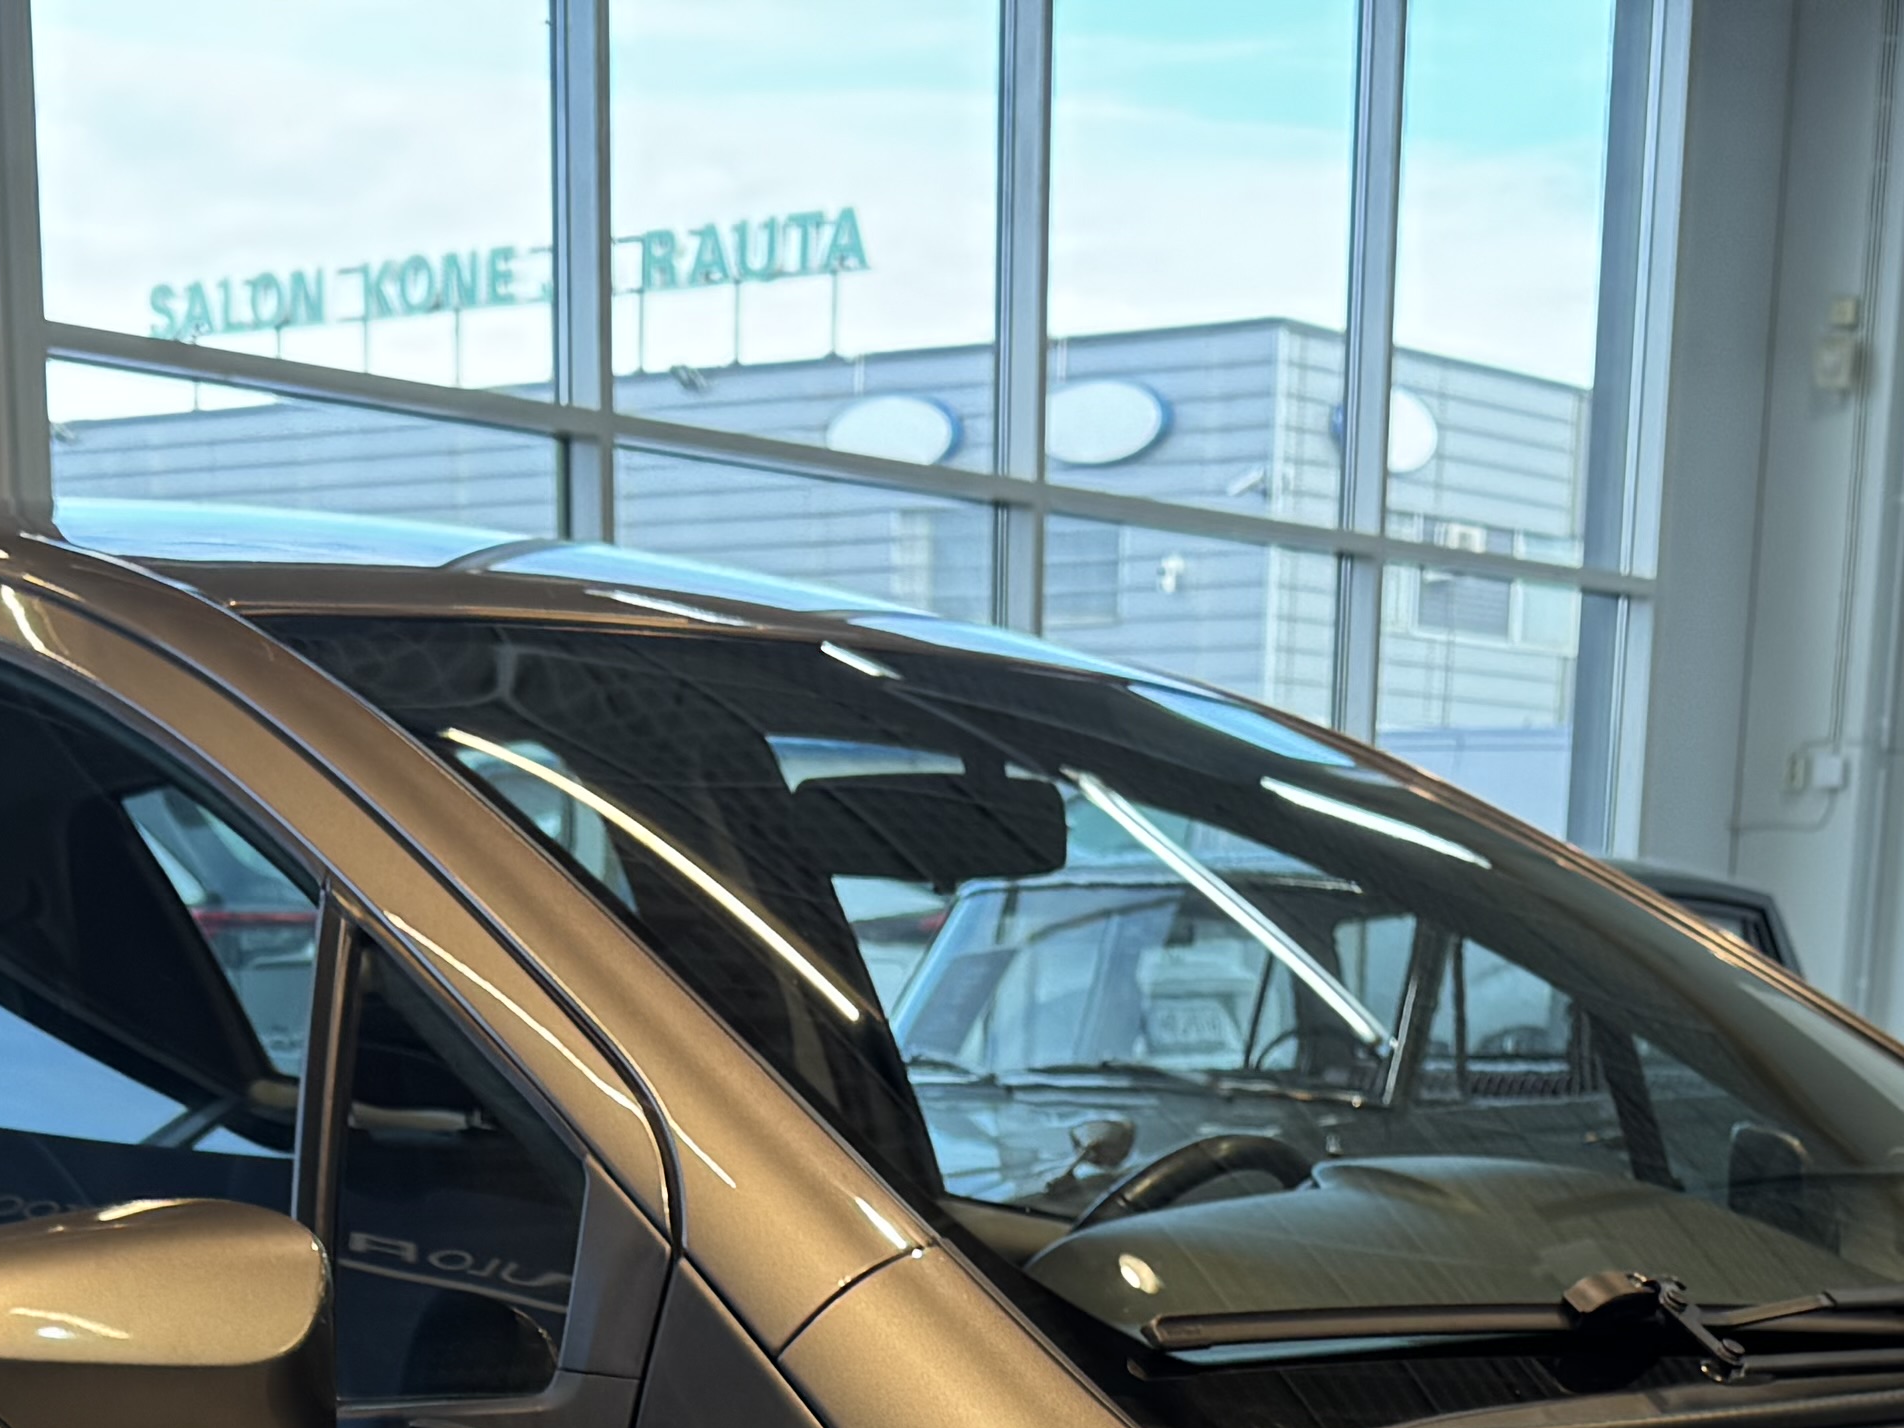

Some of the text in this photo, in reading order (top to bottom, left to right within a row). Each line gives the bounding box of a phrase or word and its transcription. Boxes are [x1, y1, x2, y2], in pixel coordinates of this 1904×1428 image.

[150, 266, 325, 340] SALON
[362, 246, 517, 320] KONE
[642, 206, 872, 292] RAUTA
